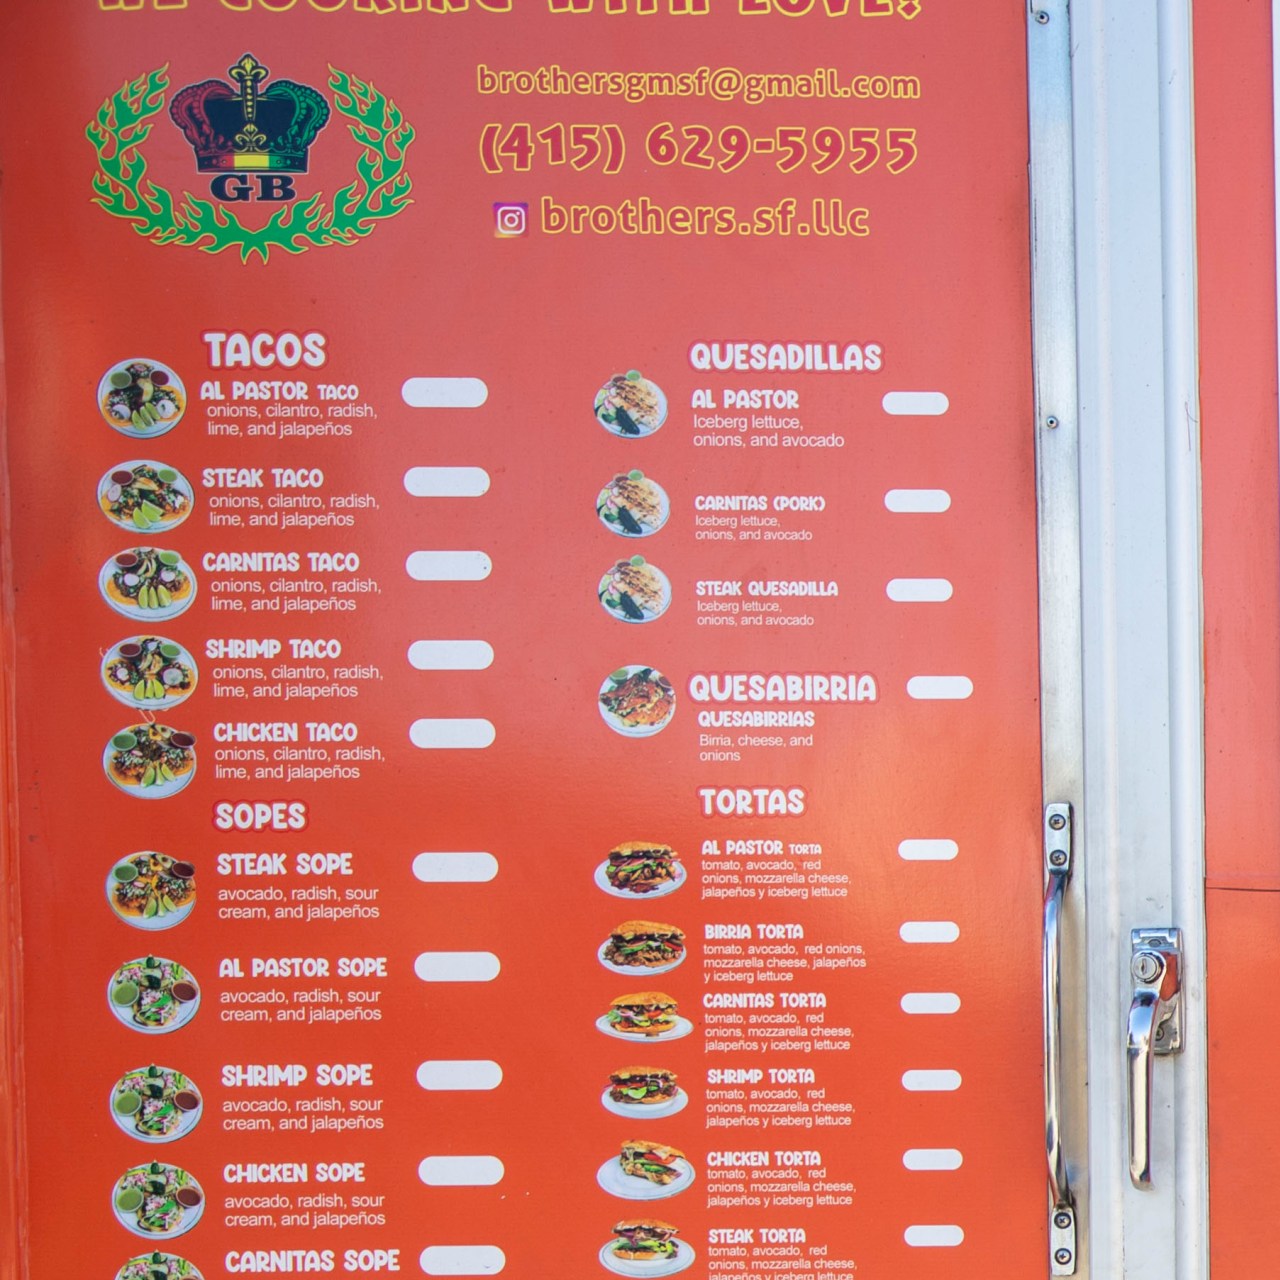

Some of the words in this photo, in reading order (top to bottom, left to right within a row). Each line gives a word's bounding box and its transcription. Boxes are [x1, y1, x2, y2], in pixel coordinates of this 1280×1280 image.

[478, 65, 921, 104] brothersgmsf@gmail.com
[479, 122, 625, 174] (415)
[645, 122, 916, 174] 629-5955
[211, 171, 296, 203] GB
[541, 196, 870, 237] brothers.sf.llc
[203, 332, 326, 368] TACOS
[690, 342, 882, 371] QUESADILLAS
[200, 380, 225, 401] AL
[232, 380, 309, 401] PASTOR
[316, 383, 359, 401] TACO
[691, 388, 717, 409] AL
[723, 388, 800, 410] PASTOR
[207, 403, 261, 418] onions,
[265, 402, 323, 419] cilantro,
[327, 402, 378, 420] radish,
[207, 421, 243, 436] lime,
[247, 421, 276, 436] and
[278, 421, 353, 440] jalapeños
[693, 413, 748, 432] Iceberg
[751, 414, 804, 431] lettuce,
[693, 433, 746, 447] onions,
[750, 432, 779, 447] and
[782, 432, 845, 448] avocado
[202, 467, 264, 489] STEAK
[270, 467, 324, 489] TACO
[694, 495, 768, 511] CARNITAS
[773, 495, 826, 512] (PORK)
[202, 551, 300, 572] CARNITAS
[306, 551, 360, 573] TACO
[695, 580, 743, 596] STEAK
[747, 580, 839, 597] QUESADILLA
[205, 638, 282, 659] SHRIMP
[288, 638, 342, 659] TACO
[689, 674, 877, 702] QUESABIRRIA
[697, 710, 815, 728] QUESABIRRIAS
[213, 721, 299, 743] CHICKEN
[305, 721, 358, 742] TACO
[699, 733, 735, 747] Birria,
[737, 734, 786, 748] cheese,
[789, 734, 814, 747] and
[699, 749, 741, 762] onions
[699, 788, 805, 815] TORTAS
[215, 802, 306, 830] SOPES
[701, 839, 721, 856] AL
[725, 839, 784, 856] PASTOR
[788, 843, 823, 855] TORTA
[216, 852, 287, 876] STEAK
[295, 852, 354, 876] SOPE
[701, 860, 743, 871] tomato,
[745, 859, 797, 871] avocado,
[802, 859, 822, 871] red
[218, 886, 287, 902] avocado,
[291, 885, 341, 901] radish,
[345, 888, 379, 901] sour
[218, 907, 270, 920] cream,
[274, 904, 304, 919] and
[306, 903, 380, 922] jalapeños
[704, 923, 752, 940] BIRRIA
[756, 923, 804, 940] TORTA
[218, 957, 245, 978] AL
[251, 957, 330, 978] PASTOR
[337, 956, 388, 978] SOPE
[702, 992, 775, 1009] CARNITAS
[779, 992, 827, 1009] TORTA
[221, 1064, 308, 1088] SHRIMP
[315, 1063, 374, 1087] SOPE
[707, 1068, 764, 1085] SHRIMP
[767, 1067, 816, 1084] TORTA
[706, 1150, 770, 1167] CHICKEN
[773, 1150, 822, 1167] TORTA
[223, 1162, 308, 1184] CHICKEN
[315, 1162, 366, 1183] SOPE
[708, 1228, 754, 1244] STEAK
[758, 1227, 806, 1244] TORTA
[224, 1249, 335, 1273] CARNITAS
[343, 1248, 401, 1272] SOPE
